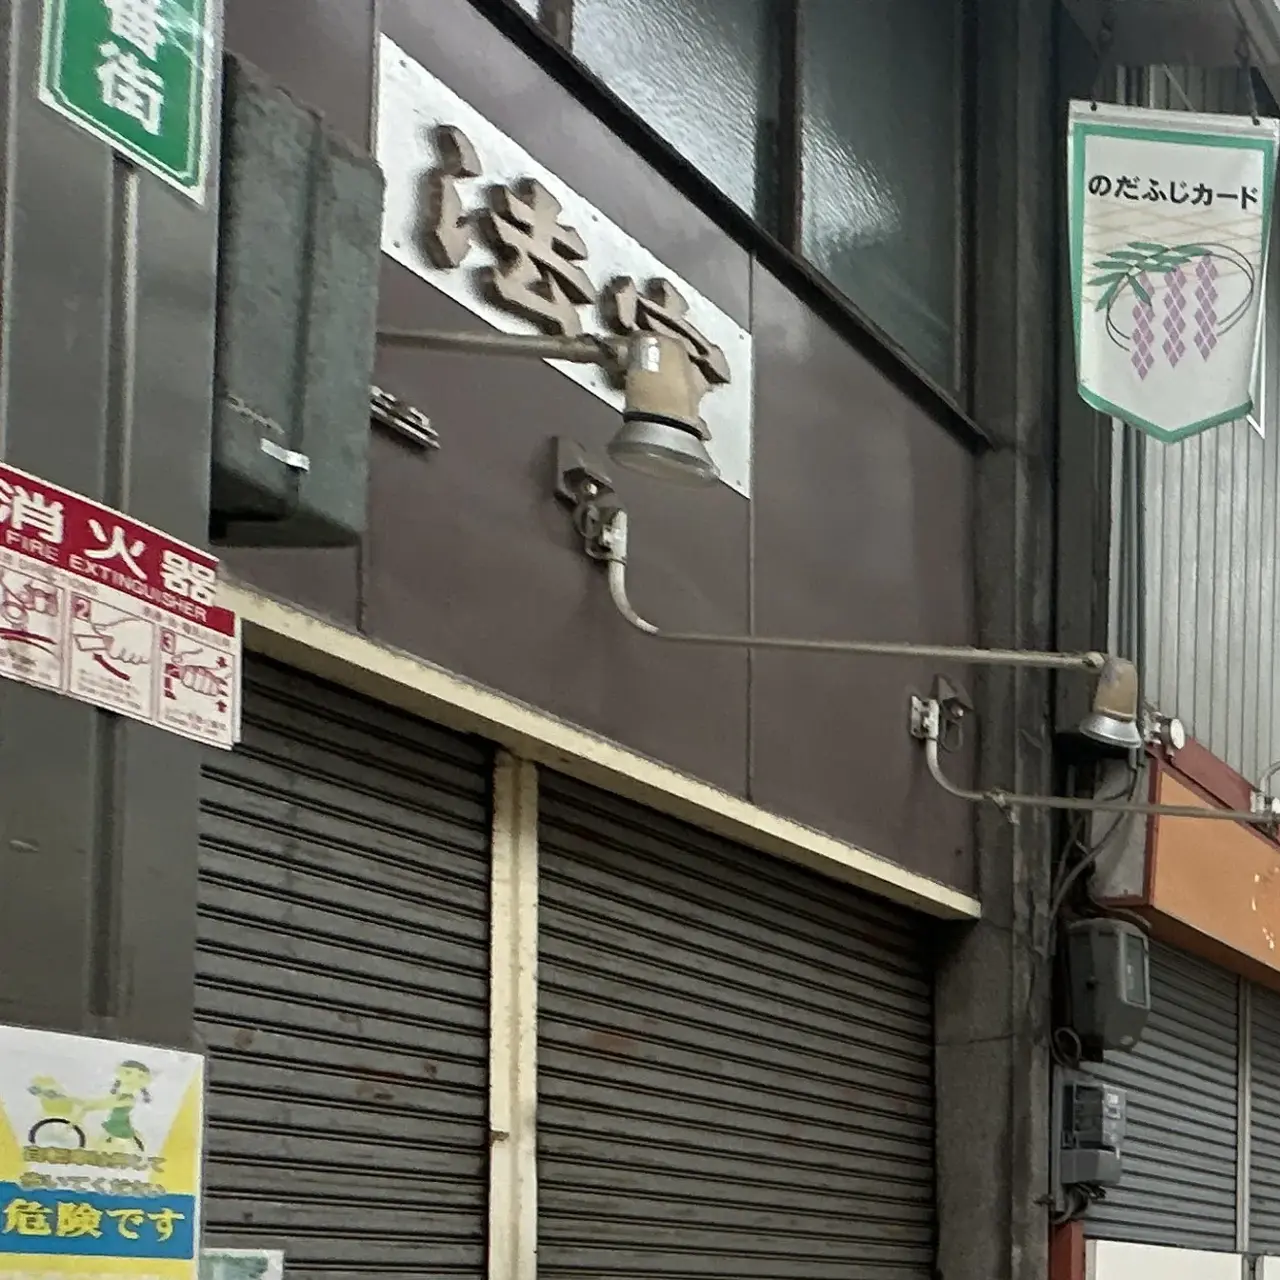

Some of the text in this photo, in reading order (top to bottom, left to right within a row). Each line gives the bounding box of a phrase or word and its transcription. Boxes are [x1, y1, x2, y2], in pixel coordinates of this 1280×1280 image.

[1088, 174, 1258, 209] のだふじカード
[0, 477, 216, 607] 消火器
[5, 529, 60, 563] FIRE
[2, 1198, 186, 1243] 危険です
